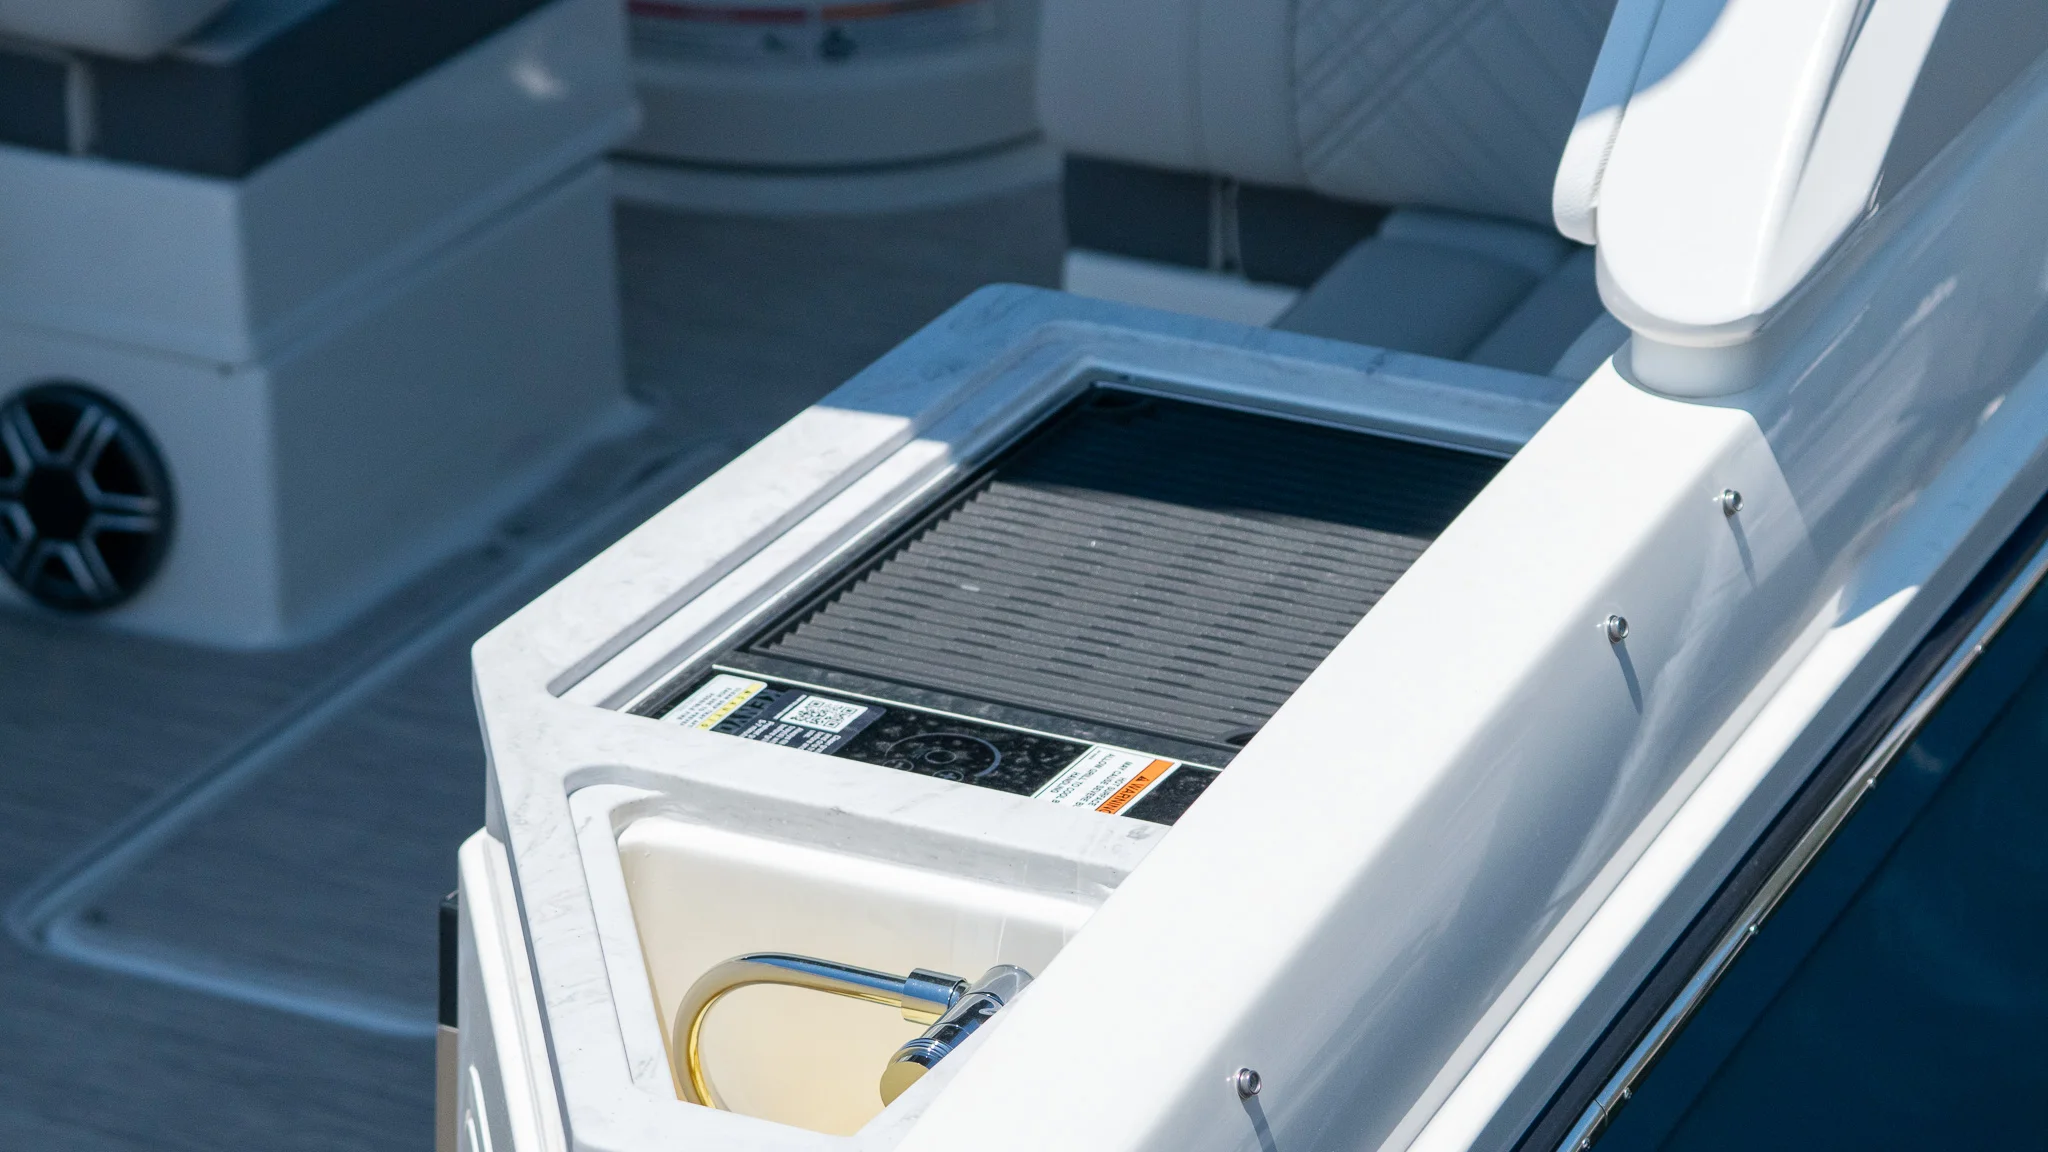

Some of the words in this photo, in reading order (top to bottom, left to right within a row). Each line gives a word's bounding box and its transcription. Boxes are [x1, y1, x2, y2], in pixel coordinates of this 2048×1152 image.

[1092, 753, 1117, 768] ALLOW
[1116, 761, 1134, 770] MAY
[1048, 771, 1081, 793] HANDLING
[1077, 768, 1098, 781] GRILL
[1099, 770, 1123, 785] CAUSE
[1110, 777, 1128, 786] HOT
[1054, 787, 1076, 799] COOL
[1078, 784, 1105, 801] SEVERE
[1086, 786, 1117, 806] SURFACE
